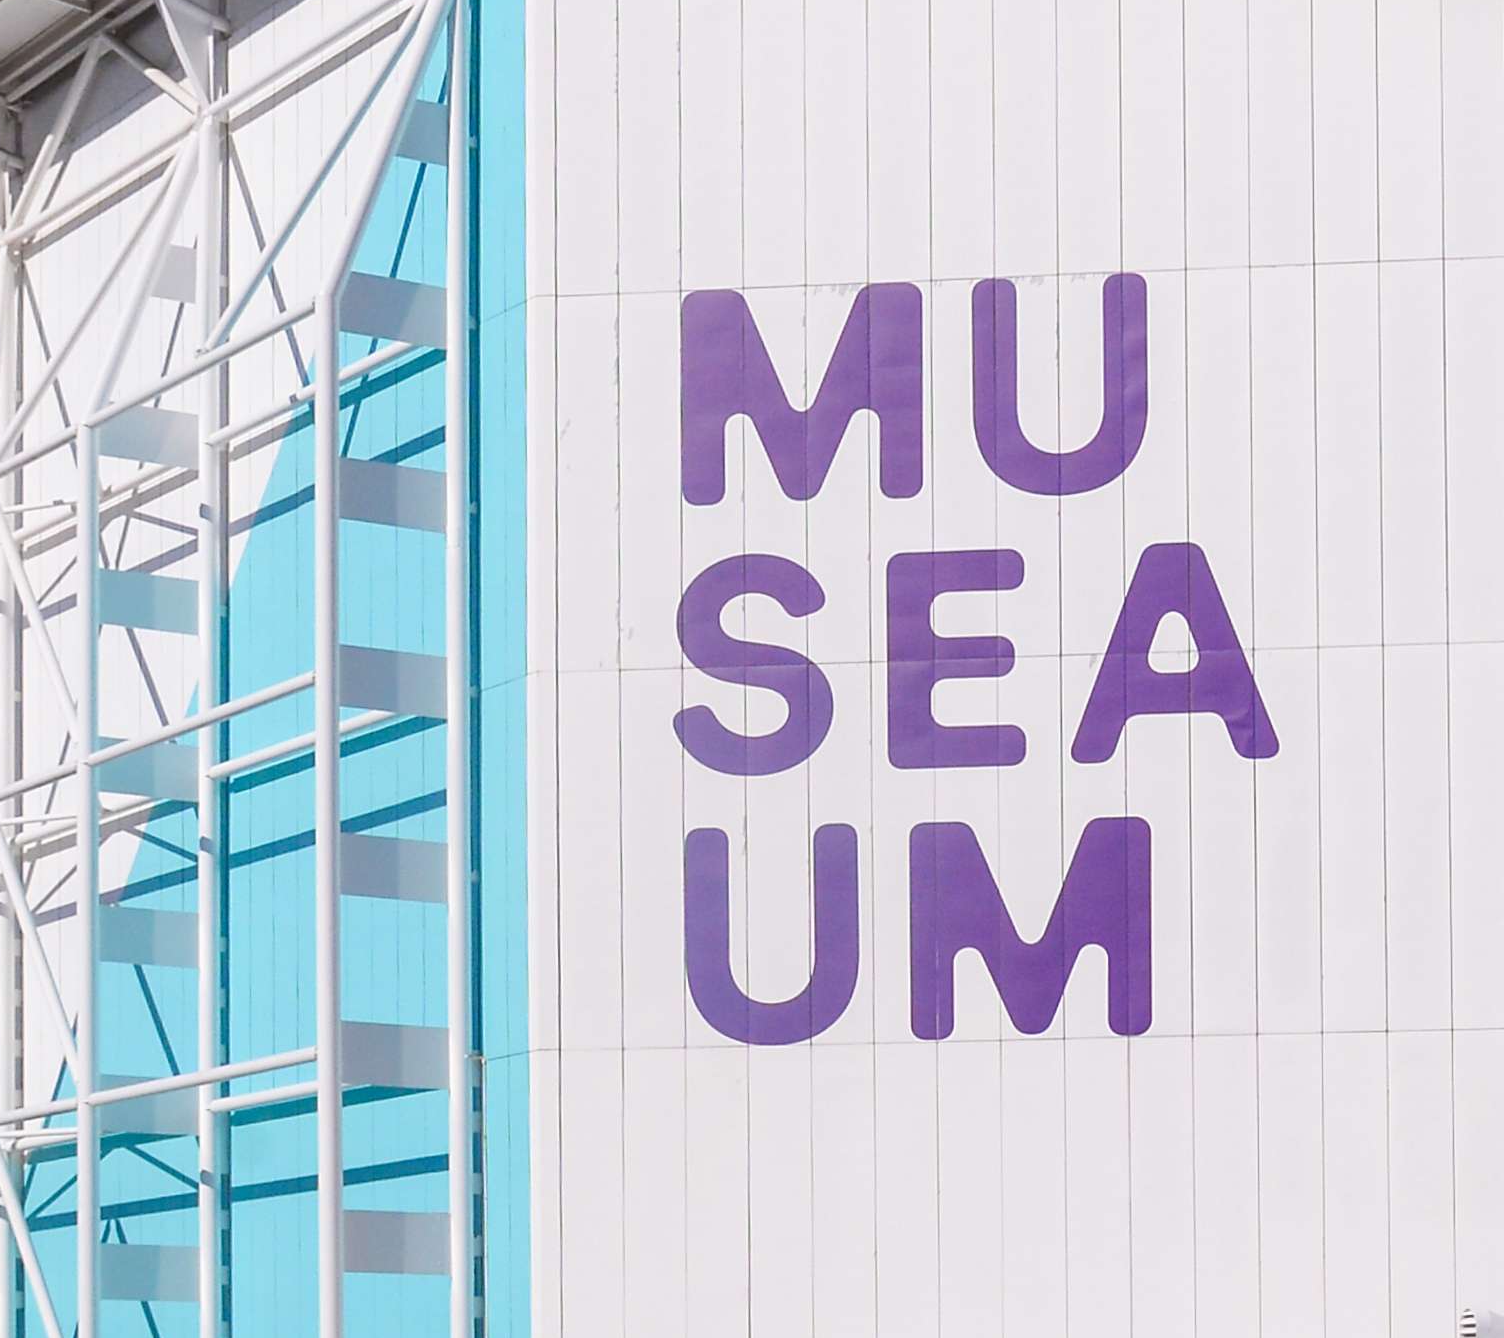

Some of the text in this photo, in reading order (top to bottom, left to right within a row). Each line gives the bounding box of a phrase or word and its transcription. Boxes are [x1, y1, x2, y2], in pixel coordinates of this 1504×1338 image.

[681, 272, 1148, 505] MU
[673, 542, 1281, 776] SEA
[685, 817, 1152, 1046] UM
